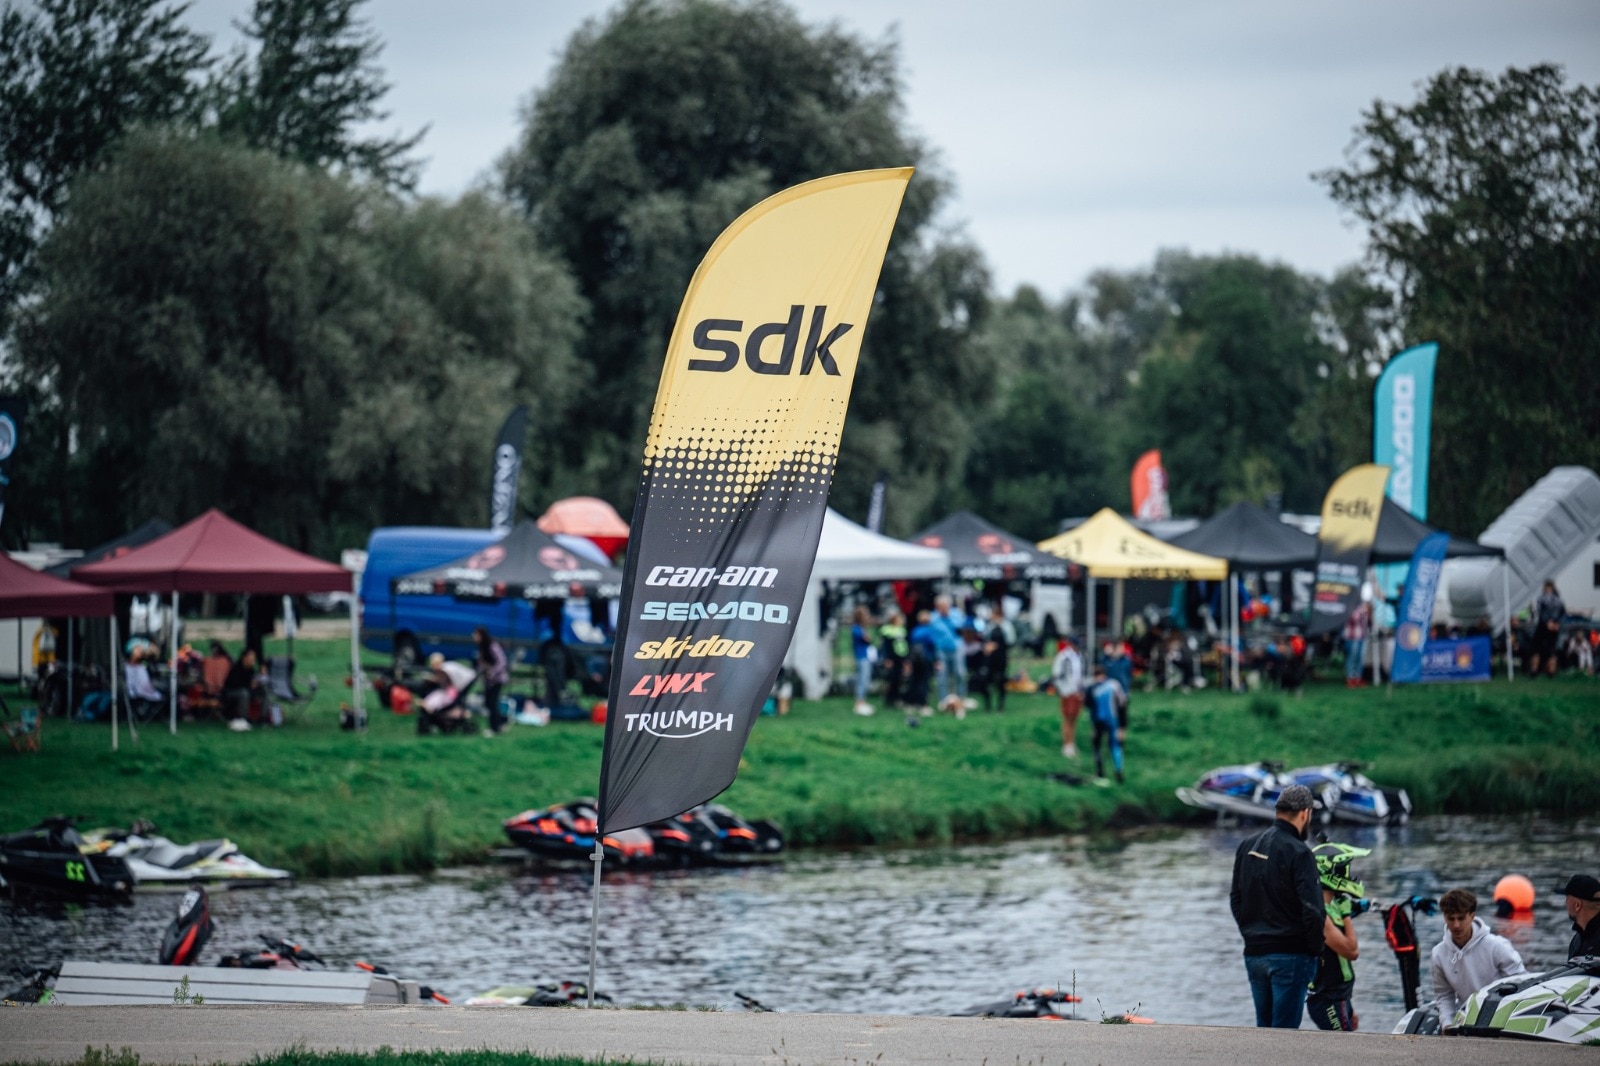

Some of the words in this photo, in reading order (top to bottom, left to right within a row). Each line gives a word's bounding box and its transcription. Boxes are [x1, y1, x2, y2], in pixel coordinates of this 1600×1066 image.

[687, 304, 854, 376] sdk
[634, 635, 755, 660] ski-doo
[629, 672, 716, 698] LYNX
[624, 710, 734, 738] TRIUMPH
